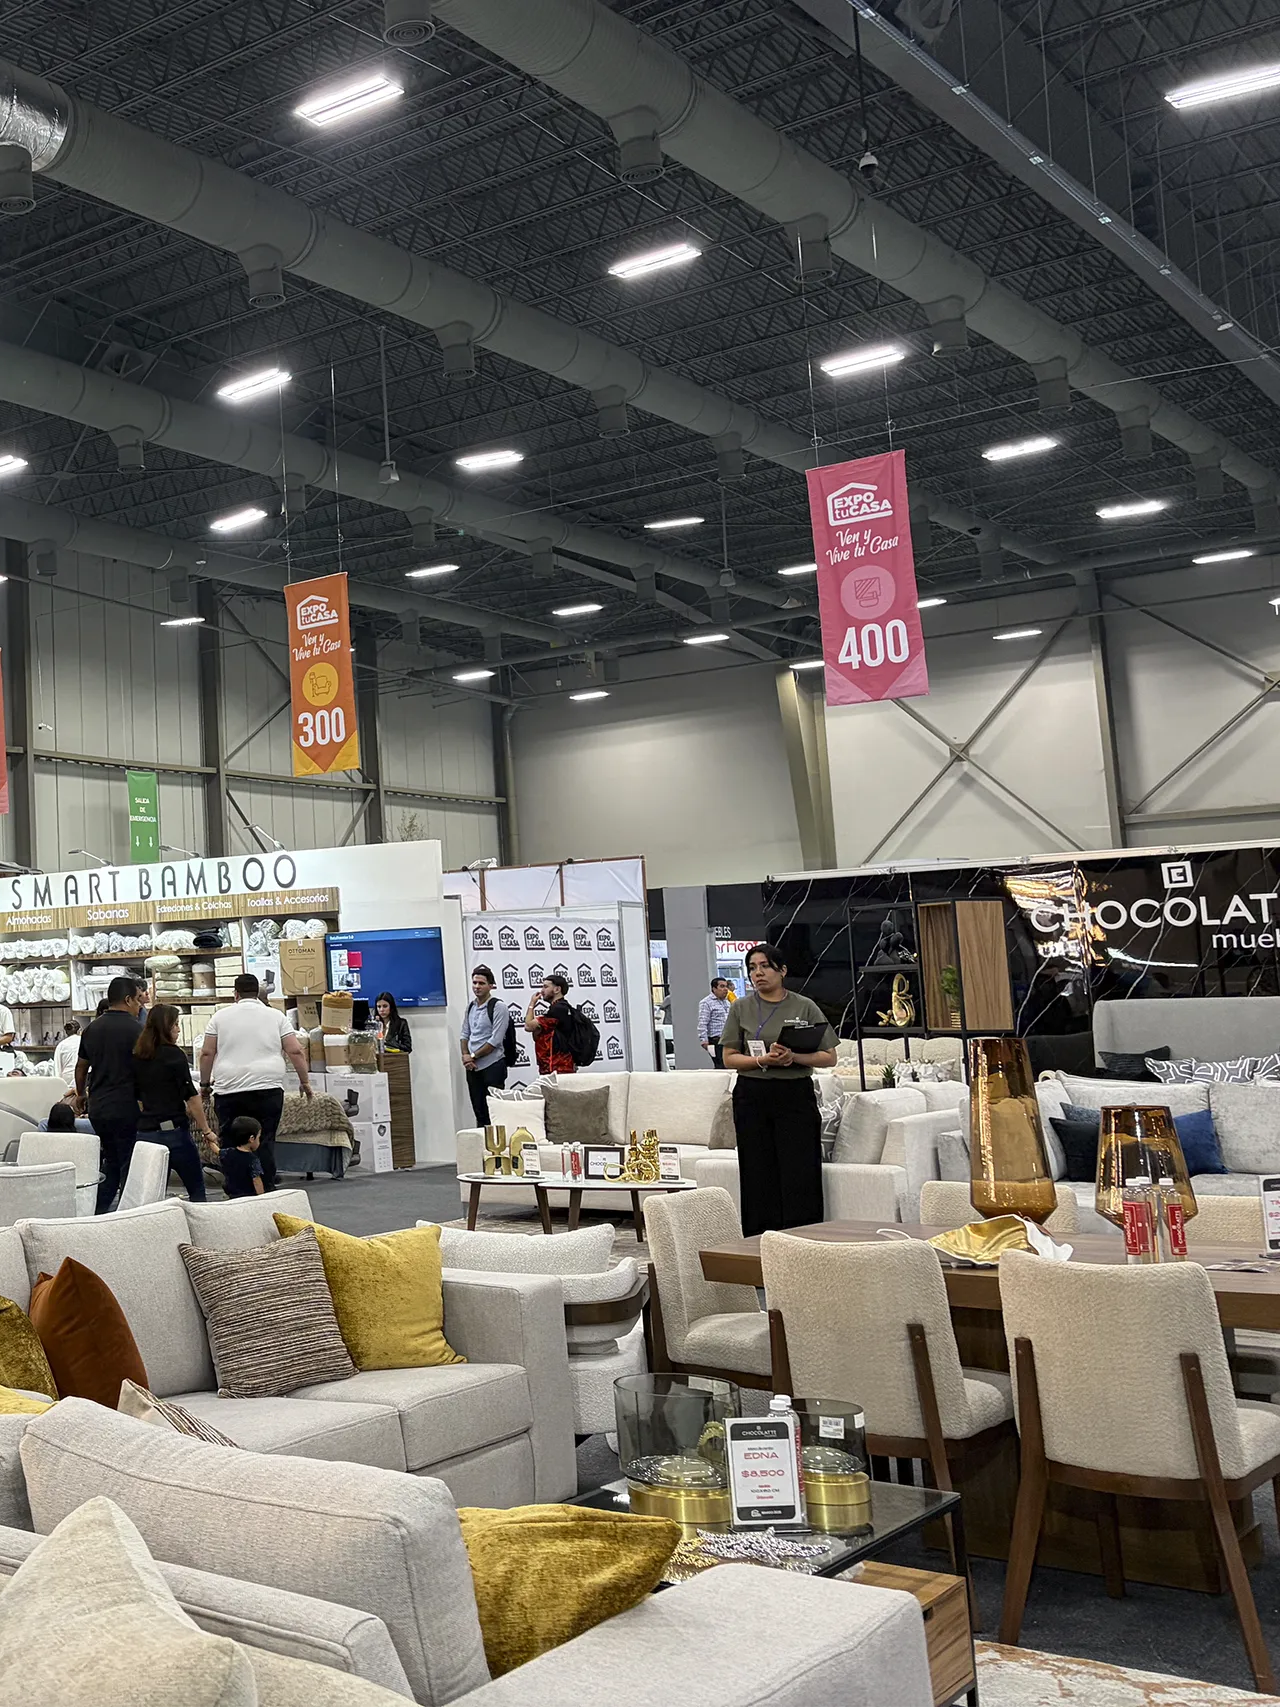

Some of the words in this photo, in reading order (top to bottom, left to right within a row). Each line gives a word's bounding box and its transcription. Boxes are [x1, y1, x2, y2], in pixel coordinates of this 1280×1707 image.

[834, 491, 875, 509] EXPO
[834, 499, 892, 519] tuCASA
[836, 528, 860, 547] Ven
[825, 546, 850, 566] Vive
[854, 542, 866, 558] tu
[869, 535, 899, 554] Casa
[301, 603, 327, 616] EXPO
[302, 632, 318, 647] Ven
[838, 619, 910, 670] 400
[292, 646, 311, 662] Vive
[323, 638, 341, 654] Casa
[298, 706, 346, 748] 300
[11, 871, 120, 910] SMART
[139, 854, 297, 900] BAMBOO
[156, 903, 193, 913] Edredones
[194, 902, 200, 911] &
[201, 900, 232, 910] Colchas
[247, 897, 273, 907] Toallas
[275, 896, 281, 905] &
[283, 893, 329, 905] Accesorios
[6, 914, 52, 926] Almohadas
[86, 908, 129, 920] Sabanas
[1030, 892, 1278, 933] CHOCOLAT
[743, 1452, 779, 1460] EDNA
[741, 1469, 785, 1478] $8,500
